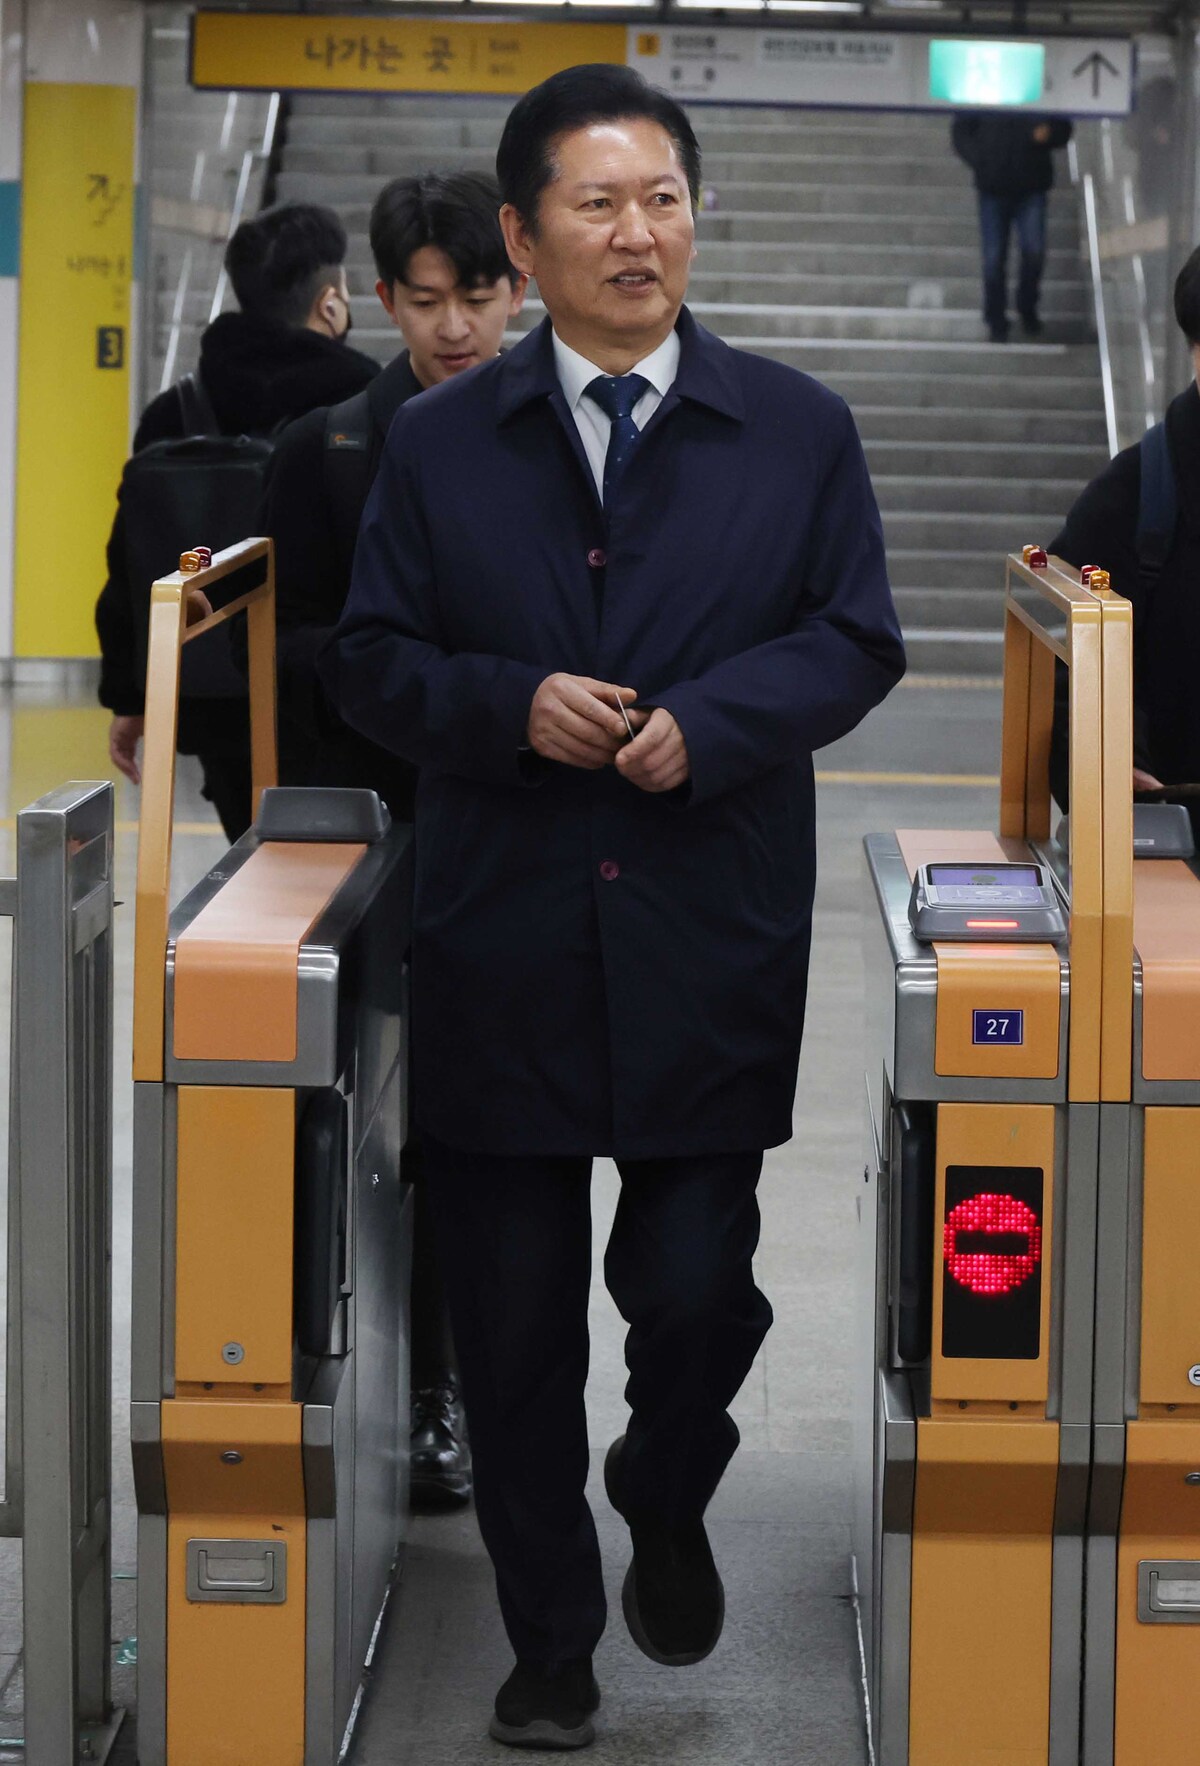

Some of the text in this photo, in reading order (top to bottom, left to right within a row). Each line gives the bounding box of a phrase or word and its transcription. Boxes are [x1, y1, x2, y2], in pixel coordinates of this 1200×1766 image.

[304, 36, 455, 74] 나가는 곳
[986, 1018, 1010, 1035] 27
